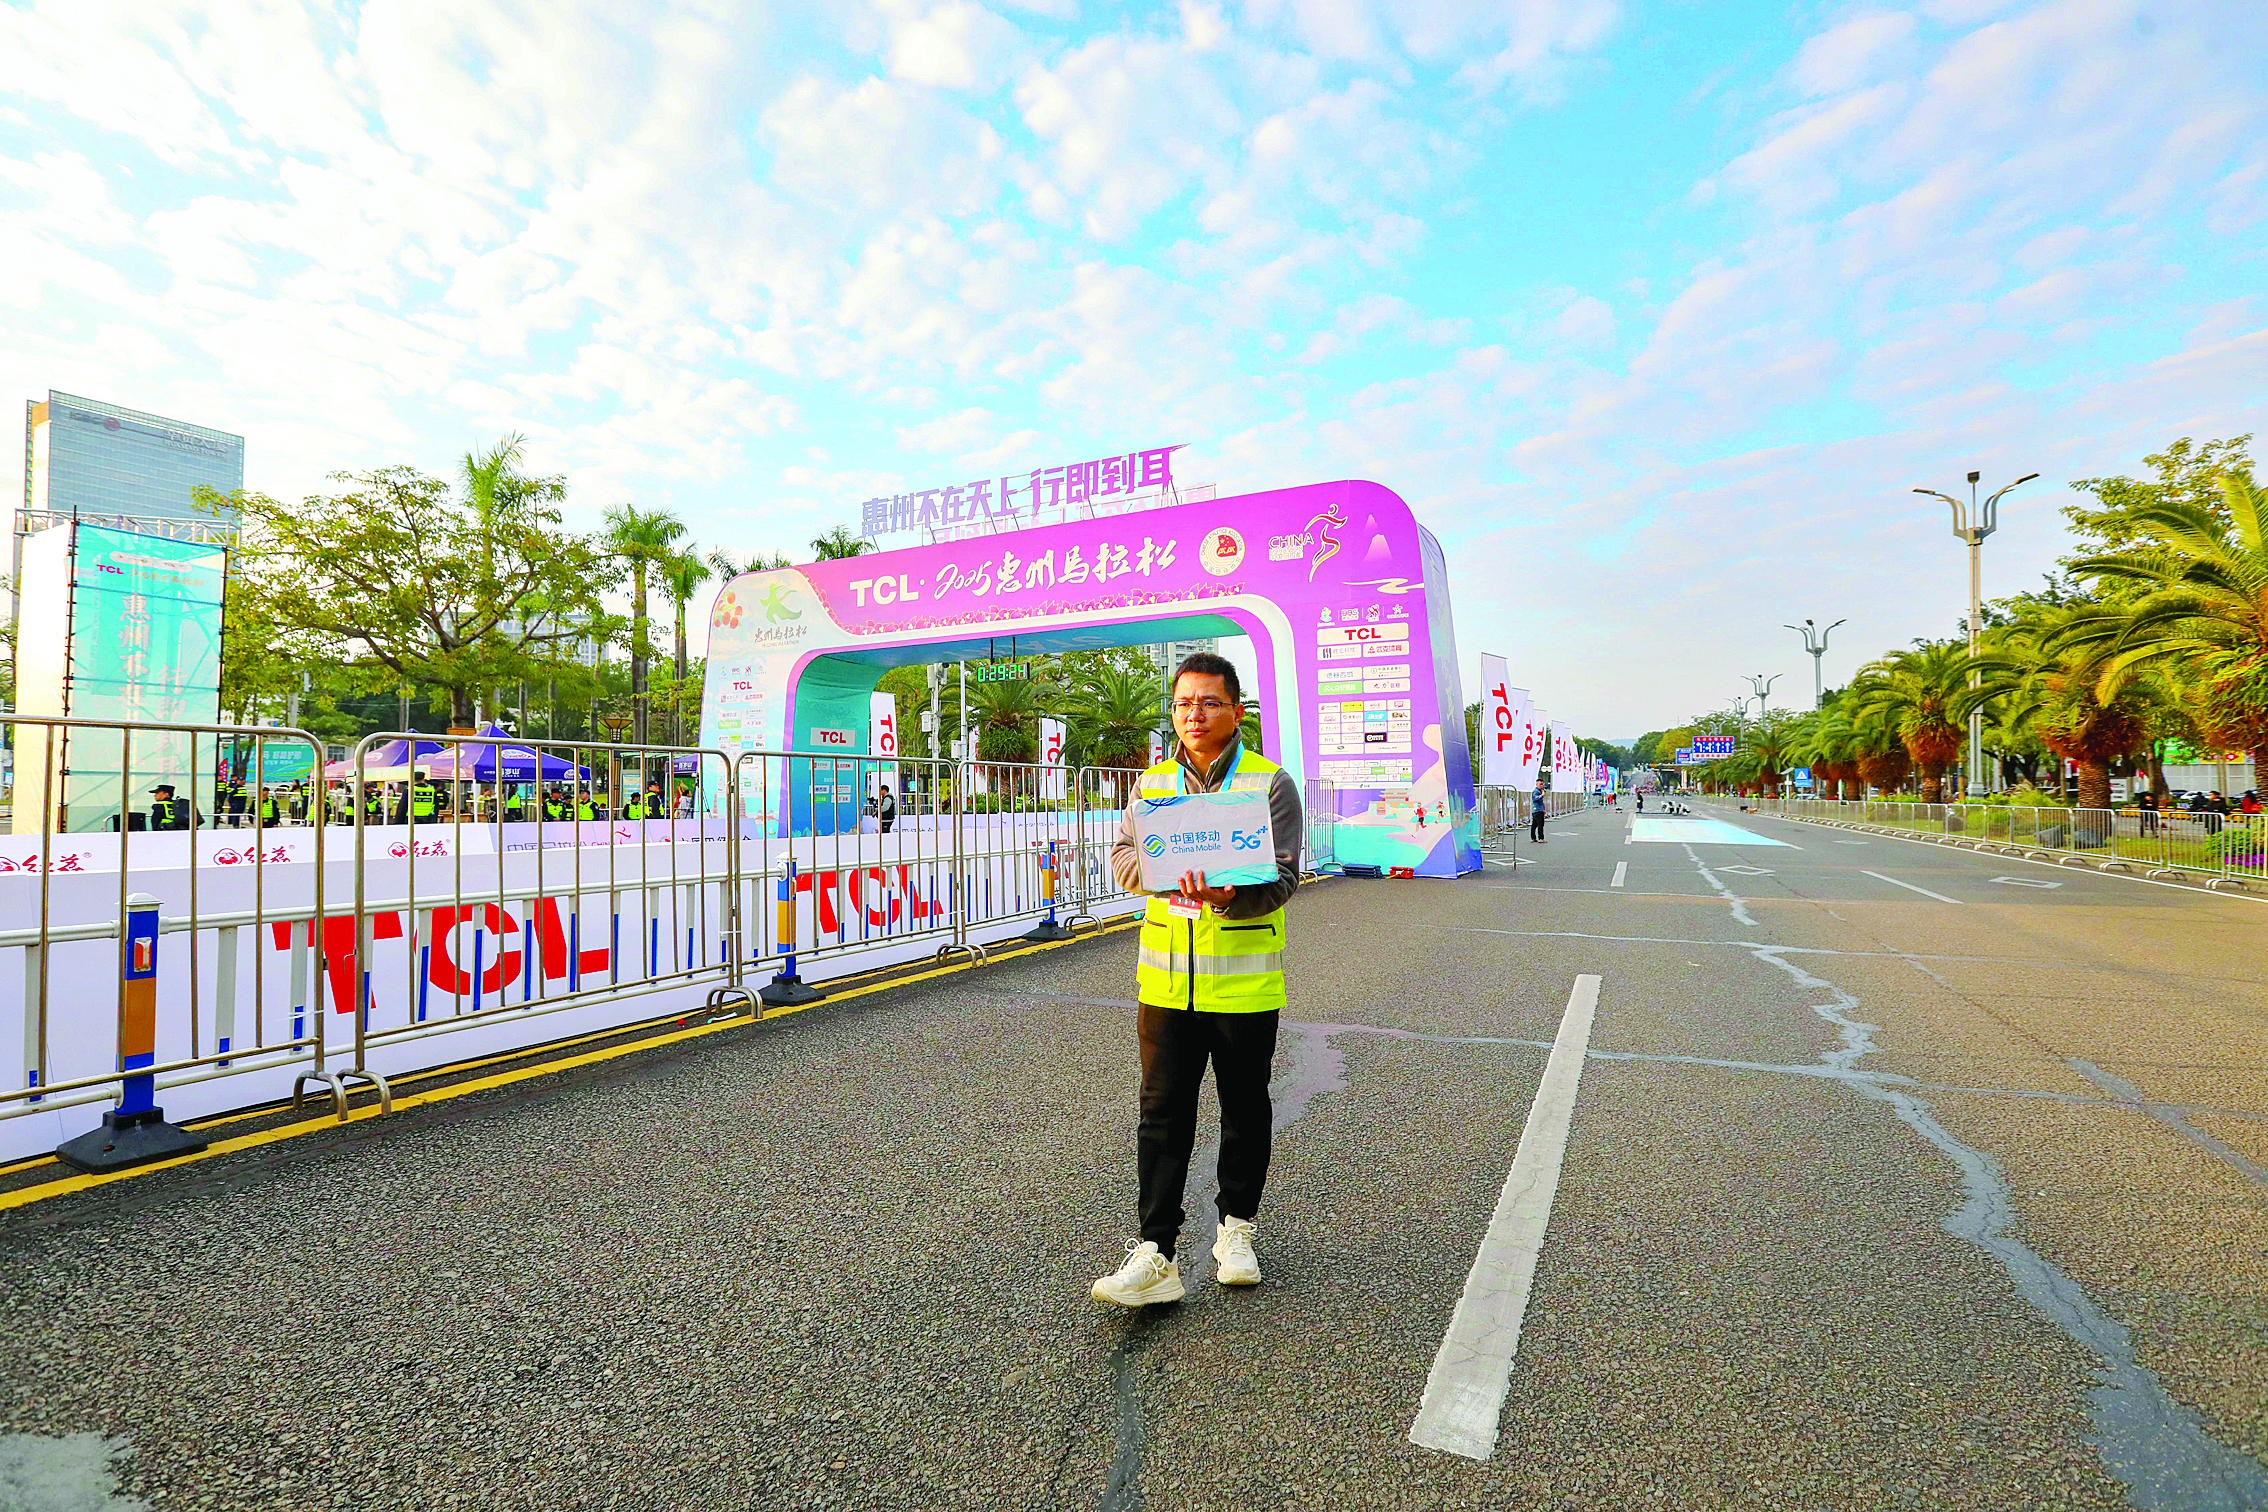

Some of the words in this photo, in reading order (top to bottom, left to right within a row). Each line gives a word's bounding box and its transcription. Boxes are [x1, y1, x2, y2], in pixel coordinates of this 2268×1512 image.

[1269, 532, 1315, 548] CHINA
[96, 564, 124, 575] TCL
[1344, 628, 1381, 640] TCL
[977, 664, 1027, 682] 0:29:24
[733, 681, 753, 691] TCL
[1492, 683, 1512, 751] TCL
[820, 731, 847, 744] TCL
[1170, 830, 1221, 845] 中国移动
[1171, 846, 1195, 854] China
[1195, 843, 1221, 852] Mobile
[796, 864, 945, 934] TCL
[272, 897, 609, 1014] TCL
